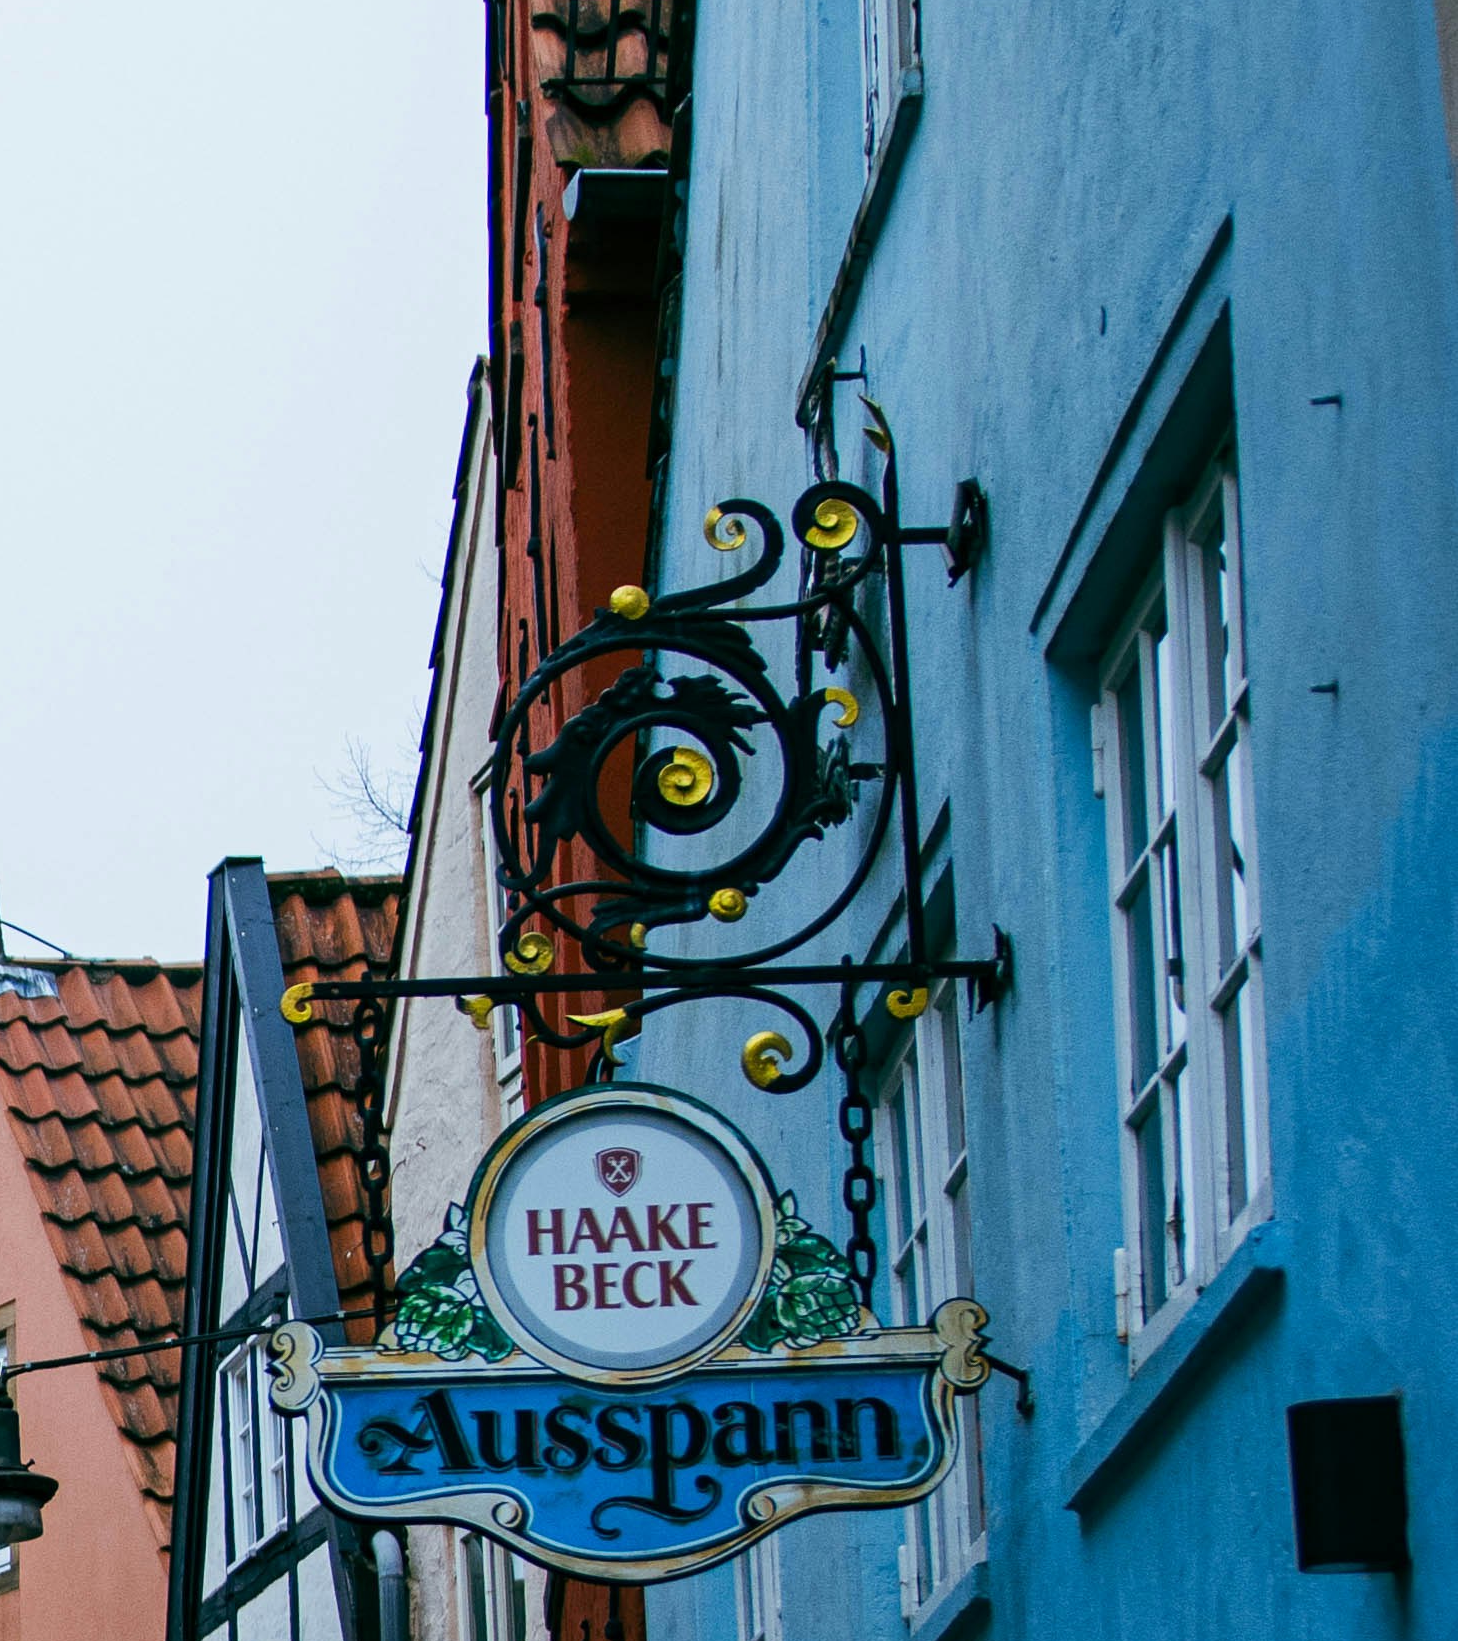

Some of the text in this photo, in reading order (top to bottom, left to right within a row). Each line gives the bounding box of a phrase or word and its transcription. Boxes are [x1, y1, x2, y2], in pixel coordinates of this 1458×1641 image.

[526, 1201, 719, 1257] HAAKE
[553, 1260, 701, 1312] BECK
[358, 1388, 902, 1540] Ausspann
